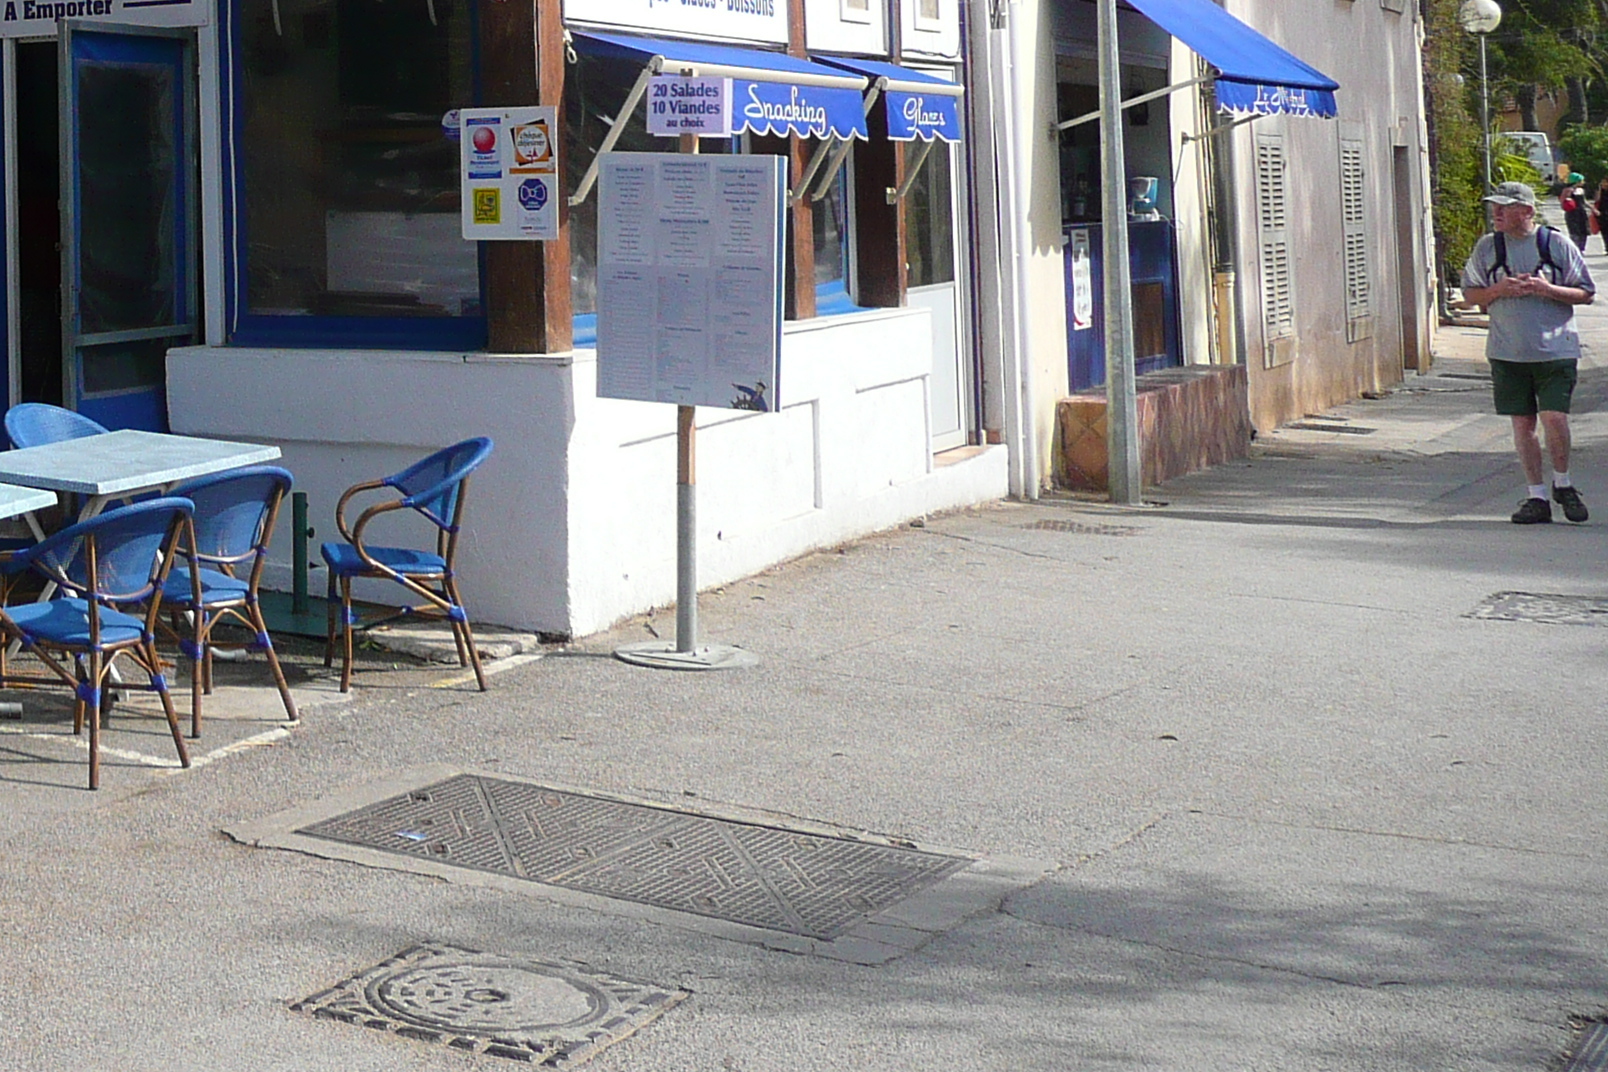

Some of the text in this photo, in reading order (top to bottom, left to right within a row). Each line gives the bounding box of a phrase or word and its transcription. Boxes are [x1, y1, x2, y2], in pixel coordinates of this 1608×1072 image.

[4, 1, 18, 21] A
[653, 82, 719, 97] 20 Salades
[652, 100, 721, 115] 10 Viandes
[744, 84, 827, 135] Snacking
[666, 116, 705, 128] au choix
